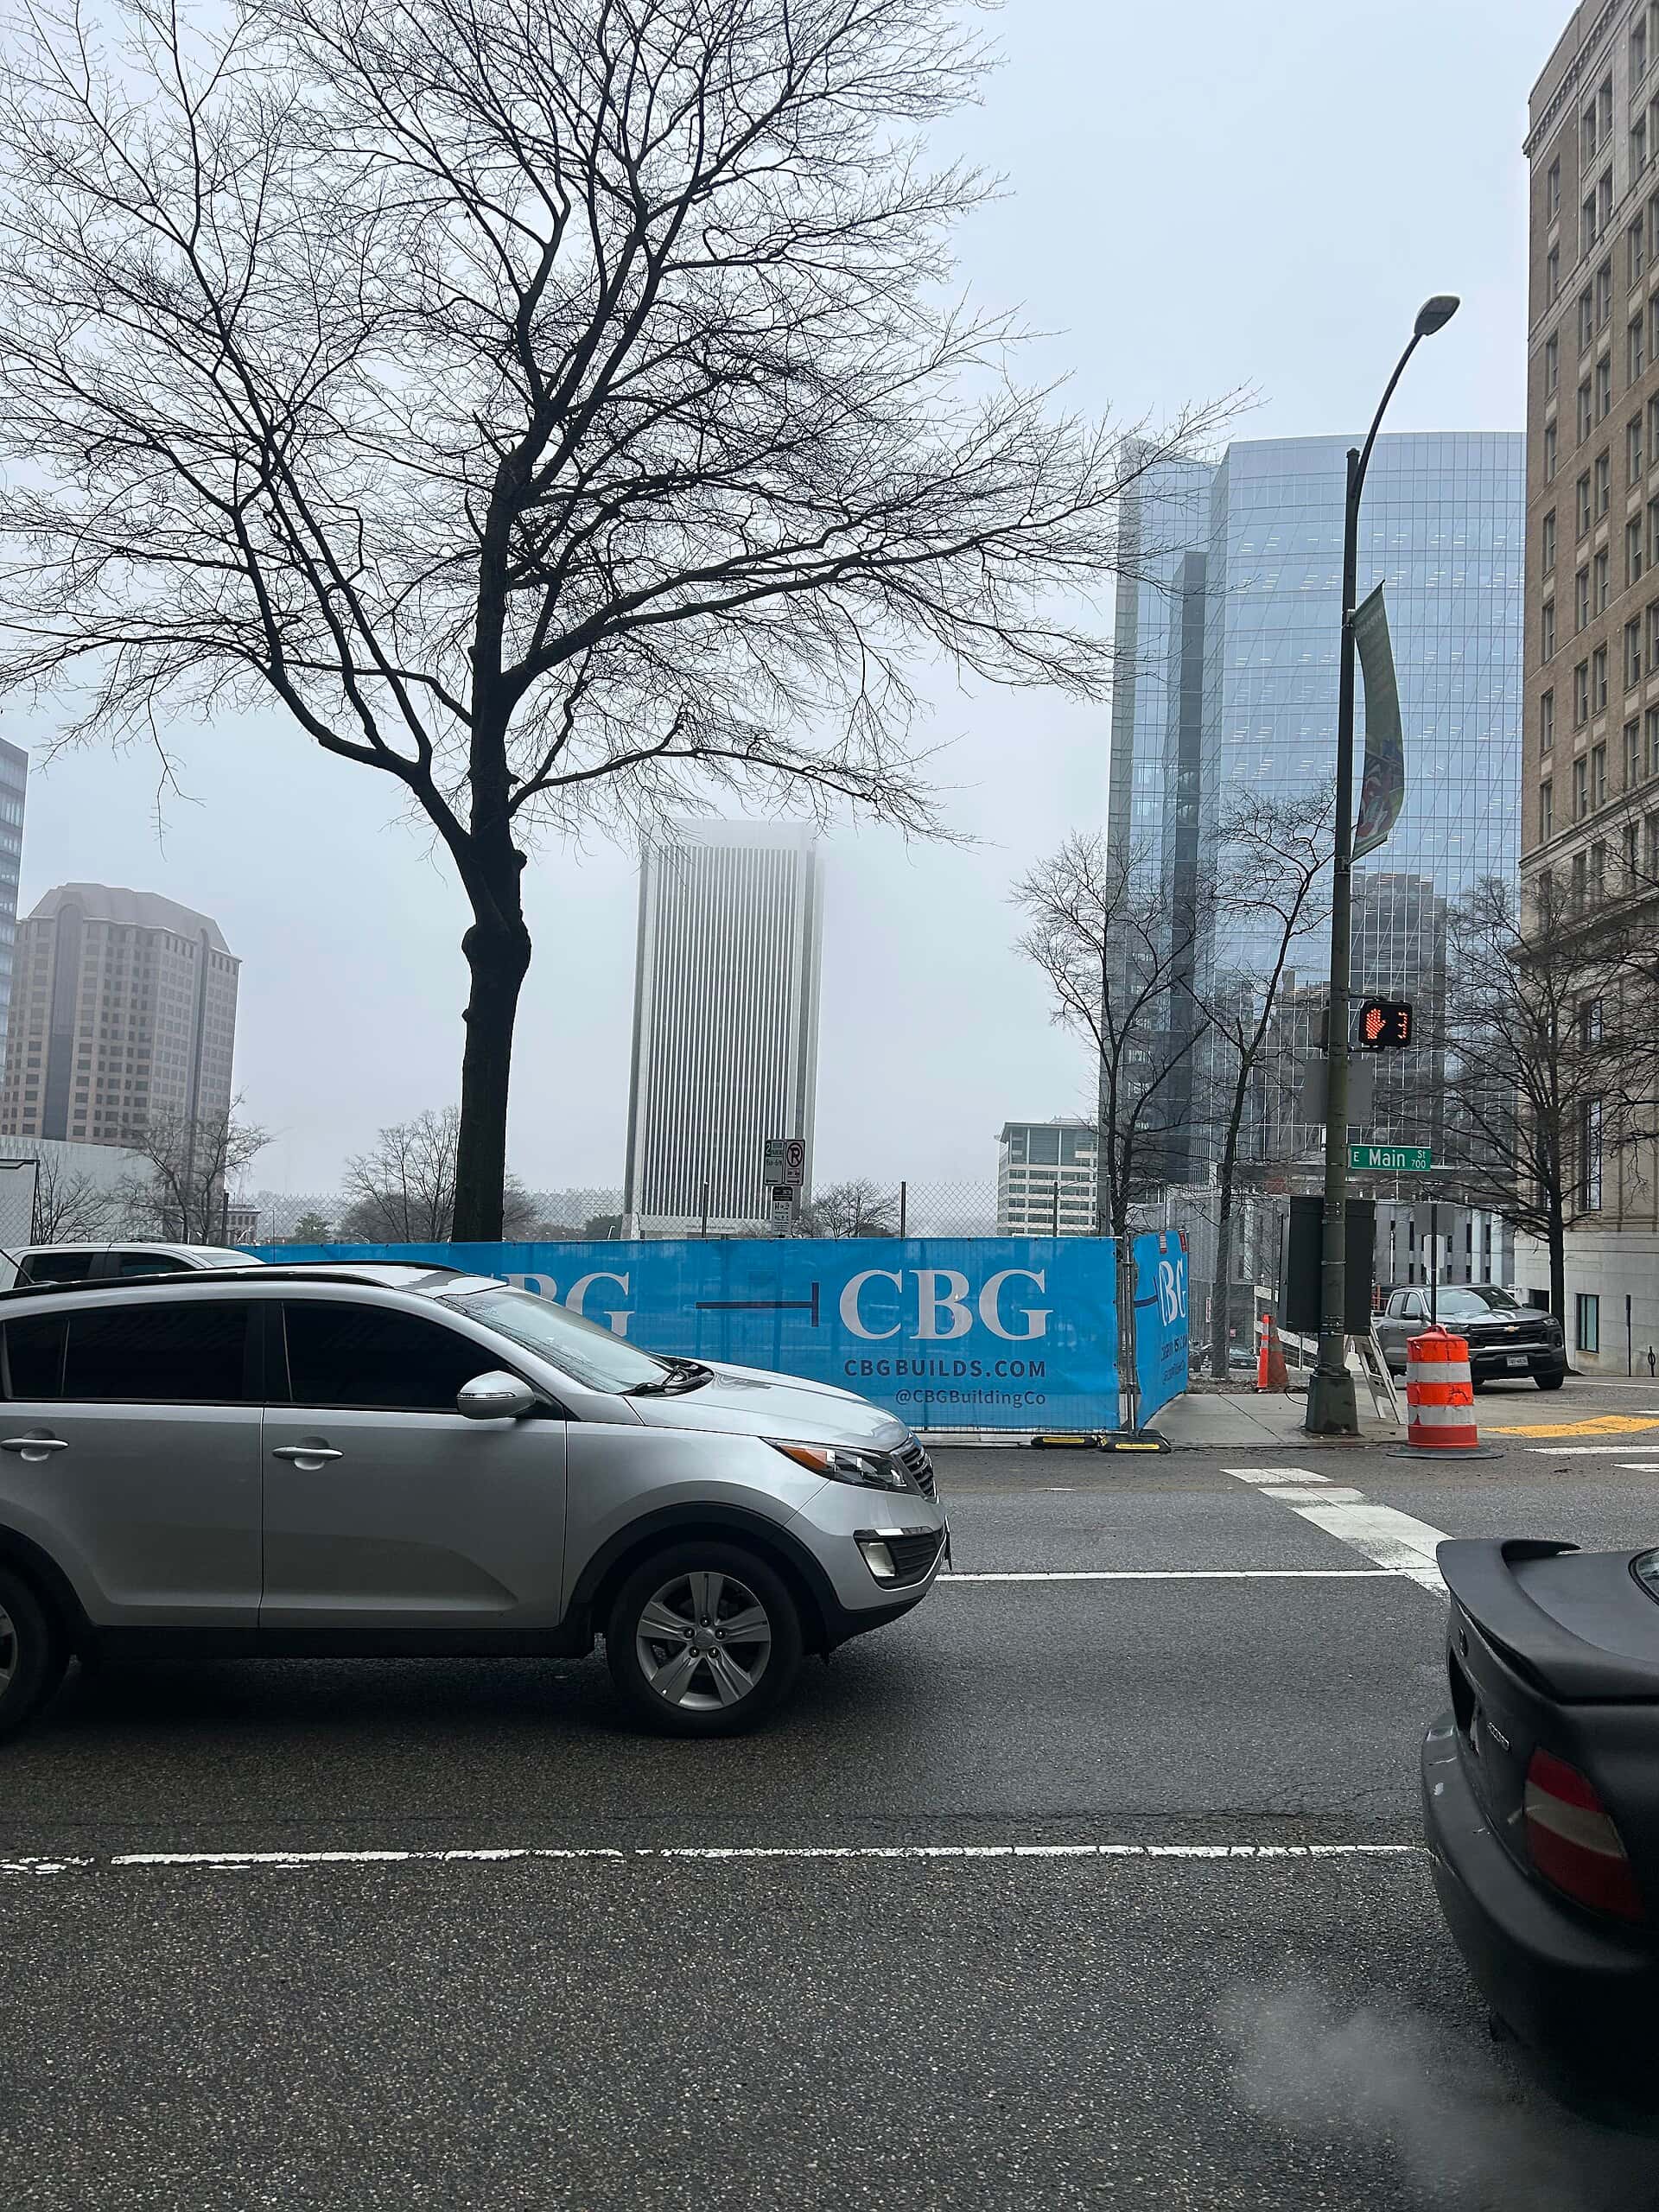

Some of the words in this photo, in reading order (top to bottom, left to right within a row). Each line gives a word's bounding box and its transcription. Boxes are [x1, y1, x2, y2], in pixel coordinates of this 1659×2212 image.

[1397, 1011, 1408, 1039] 3
[1353, 1151, 1360, 1162] E
[1369, 1147, 1406, 1167] Main
[1417, 1149, 1426, 1159] St
[1411, 1159, 1427, 1169] 700
[839, 1268, 1054, 1341] CBG
[844, 1359, 1046, 1377] CBGBUILDS.COM
[895, 1389, 1046, 1409] @CBGBuildingCo
